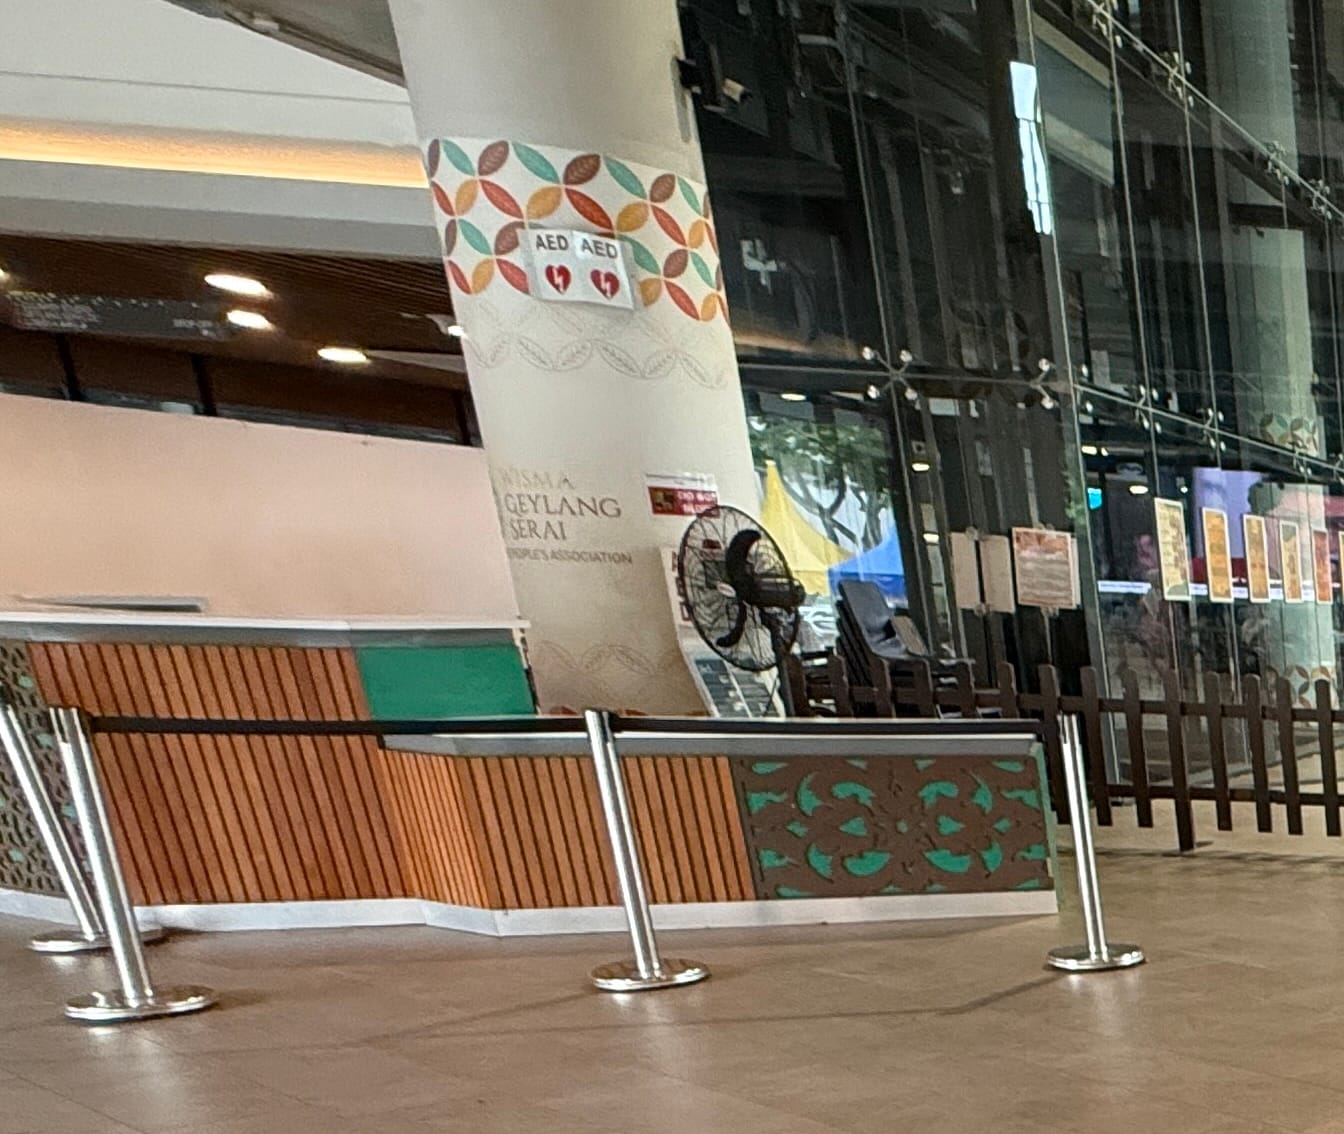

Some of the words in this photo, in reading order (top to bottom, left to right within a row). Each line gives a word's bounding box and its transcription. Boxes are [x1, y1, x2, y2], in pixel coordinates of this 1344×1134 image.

[536, 234, 568, 250] AED
[581, 238, 618, 259] AED
[506, 493, 622, 518] GEYLANG
[509, 518, 567, 541] SERAI
[551, 550, 632, 565] ASSOCIATION
